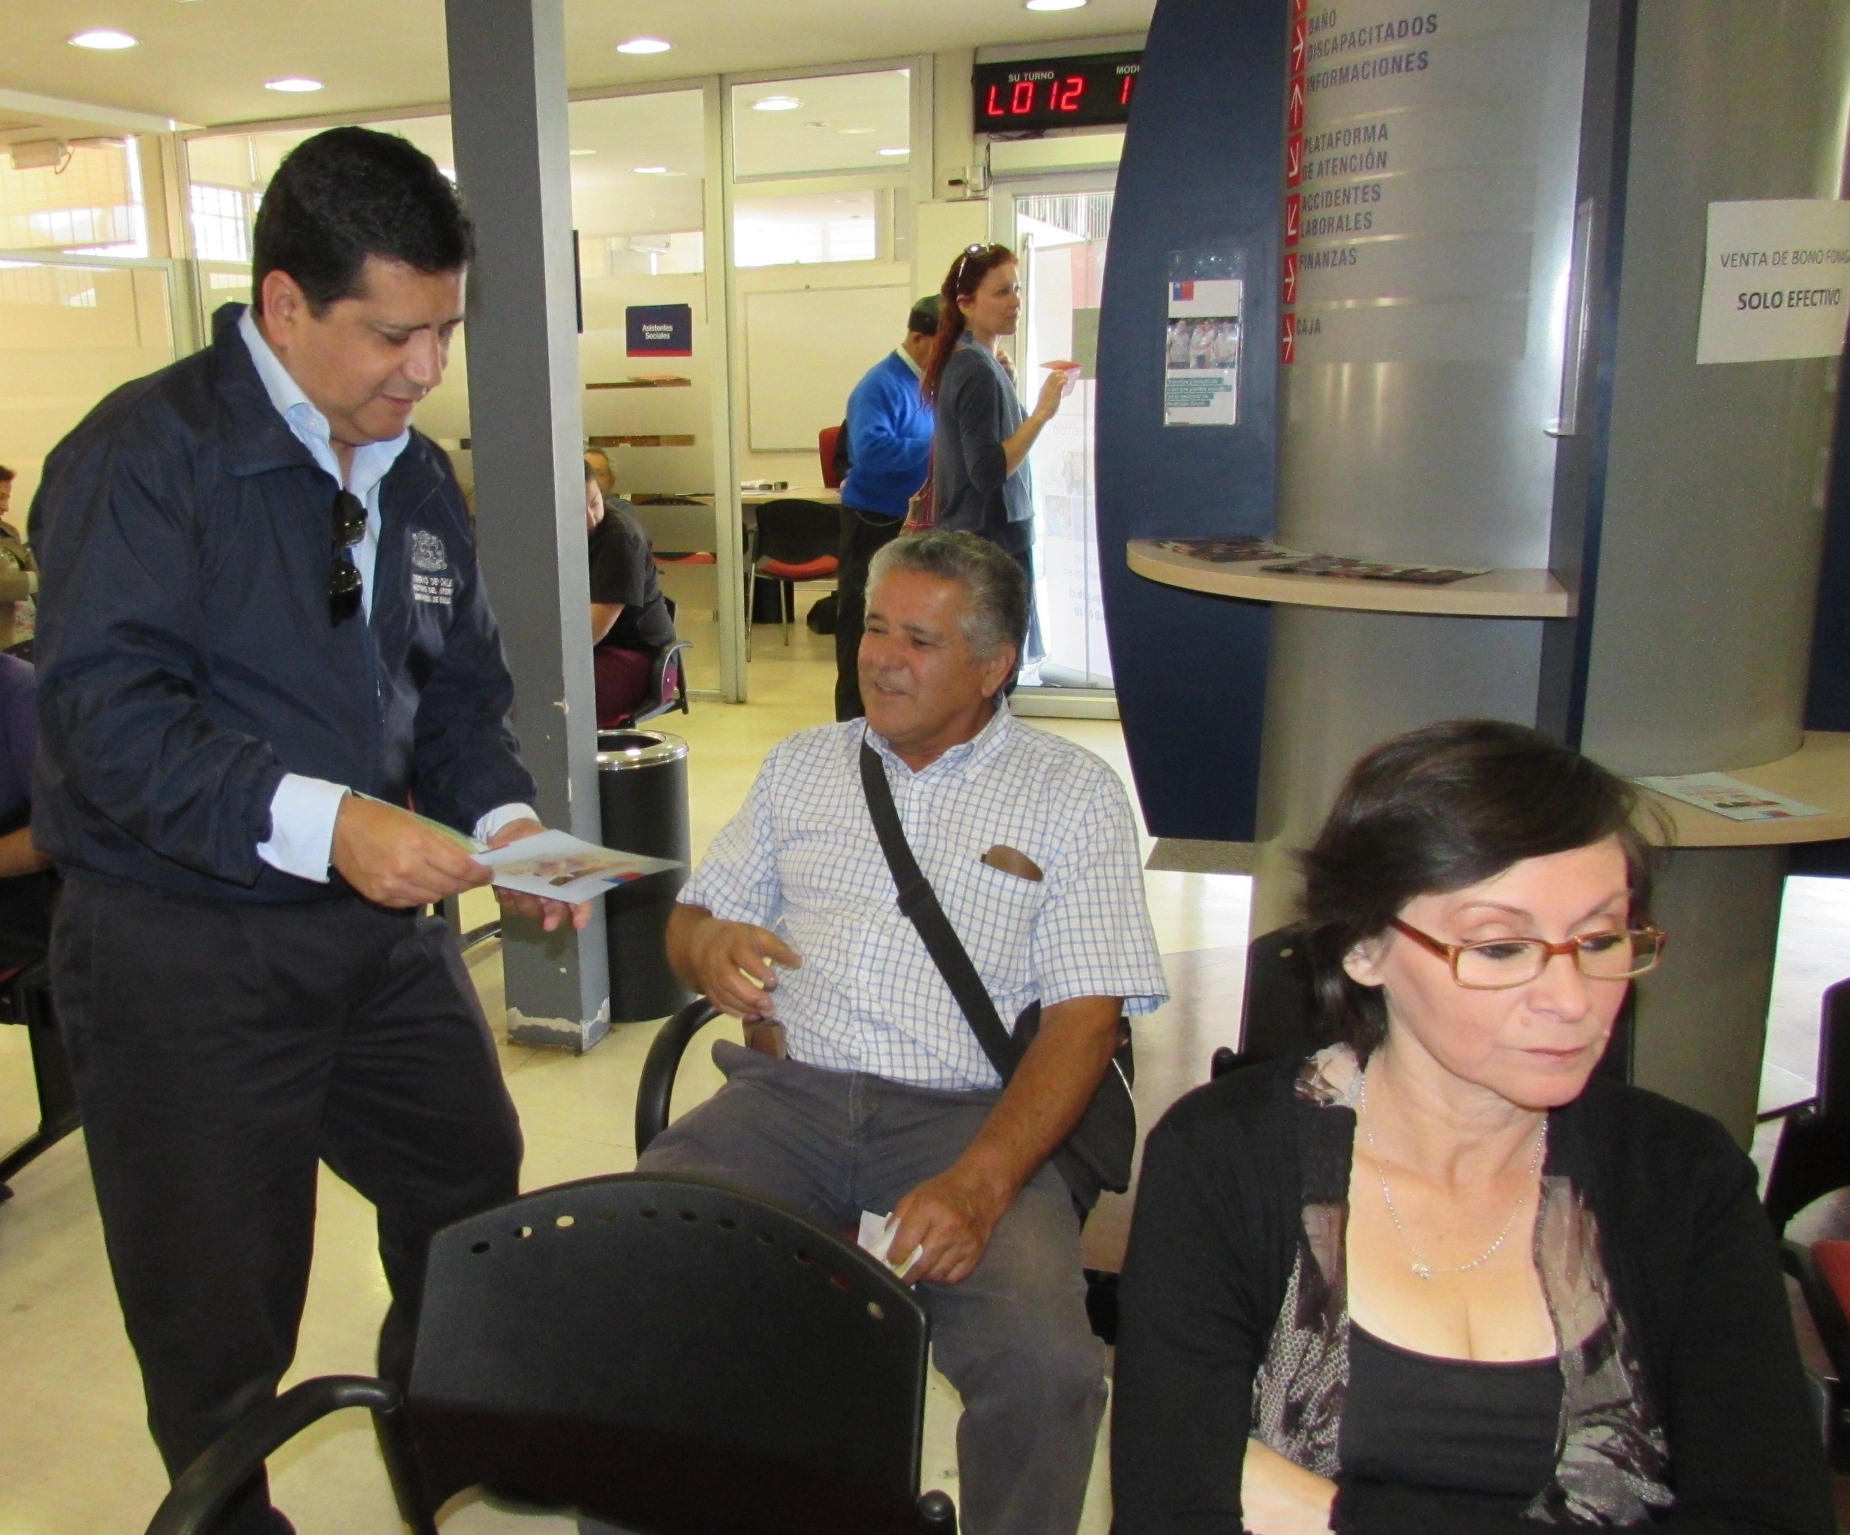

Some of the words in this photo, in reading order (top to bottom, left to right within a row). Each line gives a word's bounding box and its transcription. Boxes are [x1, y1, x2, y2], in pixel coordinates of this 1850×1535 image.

[1308, 13, 1438, 63] DISCAPACITADOS
[1008, 73, 1021, 83] SU
[1023, 71, 1055, 81] TURNO
[1307, 50, 1430, 94] INFORMACIONES
[1304, 123, 1388, 156] PLATAFORMA
[1303, 161, 1315, 182] DE
[1317, 148, 1388, 178] ATENCIÓN
[1303, 183, 1382, 213] ACCIDENTES
[1302, 211, 1374, 238] LABORALES
[1300, 247, 1357, 272] FINANZAS
[1720, 252, 1768, 268] VENTA
[1772, 251, 1789, 266] DE
[1791, 249, 1824, 265] BONO
[1737, 291, 1784, 310] SOLO
[1787, 287, 1841, 308] EFECTIVO
[642, 324, 674, 332] Asistentes
[645, 332, 671, 340] Sociales
